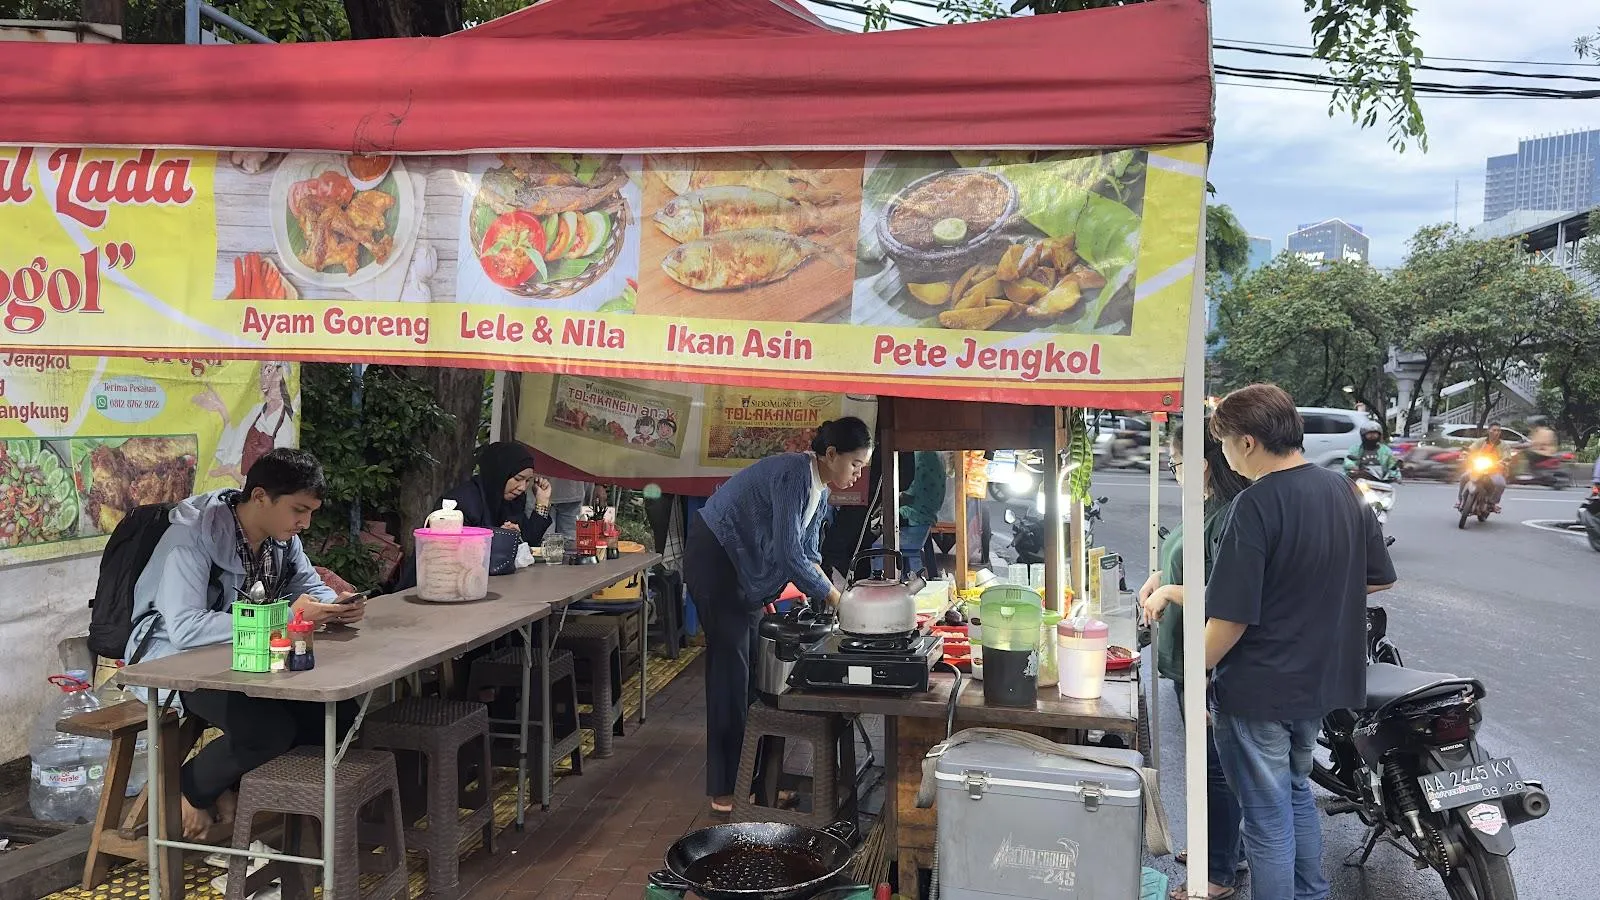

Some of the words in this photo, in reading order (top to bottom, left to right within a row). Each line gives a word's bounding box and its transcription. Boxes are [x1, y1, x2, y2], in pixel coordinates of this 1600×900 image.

[48, 148, 195, 229] Lada
[242, 306, 315, 341] Ayam
[323, 308, 430, 345] Goreng
[460, 311, 523, 342] Lele
[531, 315, 553, 346] &
[561, 318, 626, 349] Nila
[667, 324, 734, 356] Ikan
[742, 328, 813, 361] Asin
[3, 352, 71, 373] Jengkol
[873, 334, 947, 369] Pete
[955, 338, 1102, 381] Jengkol
[103, 382, 128, 392] Terima
[129, 383, 157, 393] Pesanan
[0, 401, 69, 424] angkung
[1439, 742, 1465, 752] HONDA
[1424, 777, 1446, 793] AA
[1449, 765, 1489, 787] 2445
[1490, 759, 1514, 779] KY
